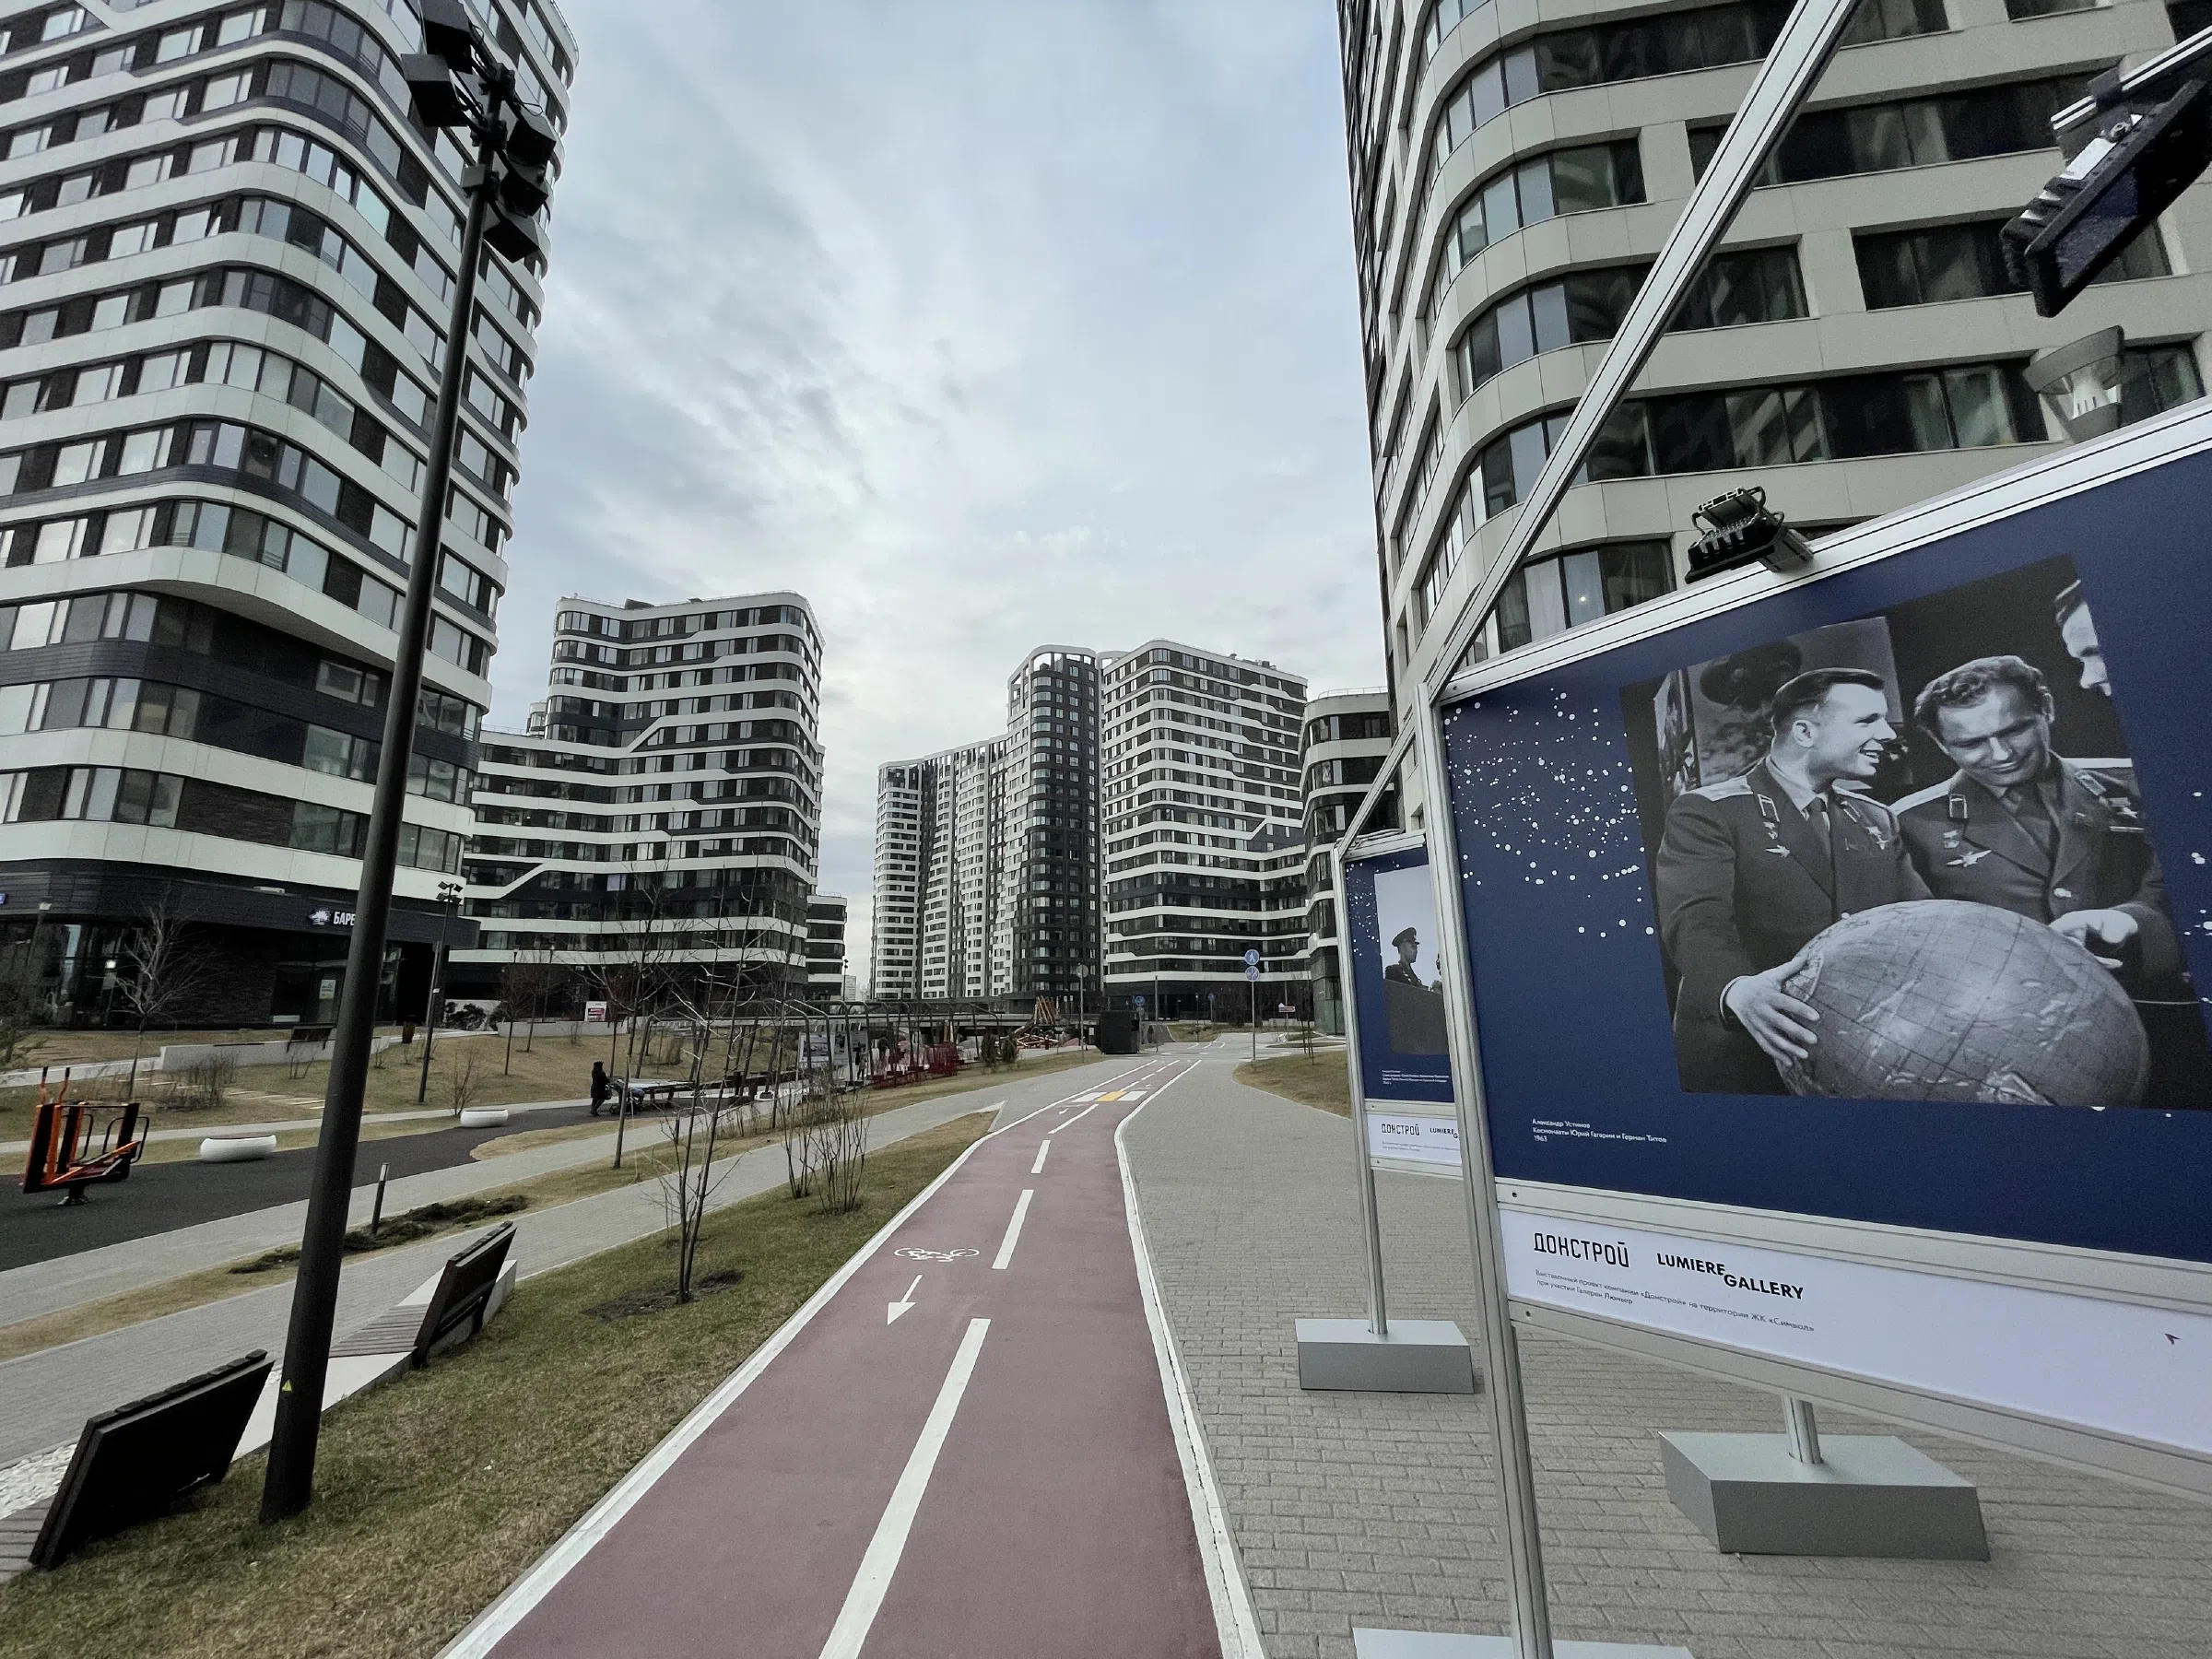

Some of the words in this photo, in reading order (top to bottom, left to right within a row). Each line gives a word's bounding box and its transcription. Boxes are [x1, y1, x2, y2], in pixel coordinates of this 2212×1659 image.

[333, 911, 356, 926] БАРЕ
[1381, 1124, 1420, 1135] ДОНСТРОЙ
[1532, 1118, 1564, 1128] Александр
[1565, 1120, 1591, 1129] Устинов
[1533, 1127, 1570, 1135] Космонавты
[1570, 1129, 1590, 1137] Юрий
[1591, 1131, 1616, 1139] Гагарин
[1621, 1133, 1646, 1142] Герман
[1647, 1135, 1667, 1143] Титов
[1534, 1232, 1630, 1268] ДОНСТРОЙ
[1656, 1253, 1725, 1276] LUMIERE
[1535, 1269, 1578, 1283] Выставочный
[1579, 1279, 1603, 1289] проект
[1604, 1284, 1639, 1297] компании
[1700, 1304, 1748, 1319] территории
[1750, 1313, 1767, 1323] ЖК
[1536, 1279, 1549, 1288] при
[1549, 1282, 1576, 1292] участии
[1576, 1286, 1603, 1298] Галереи
[1604, 1292, 1633, 1305] Люмьер
[1724, 1274, 1804, 1300] GALLERY
